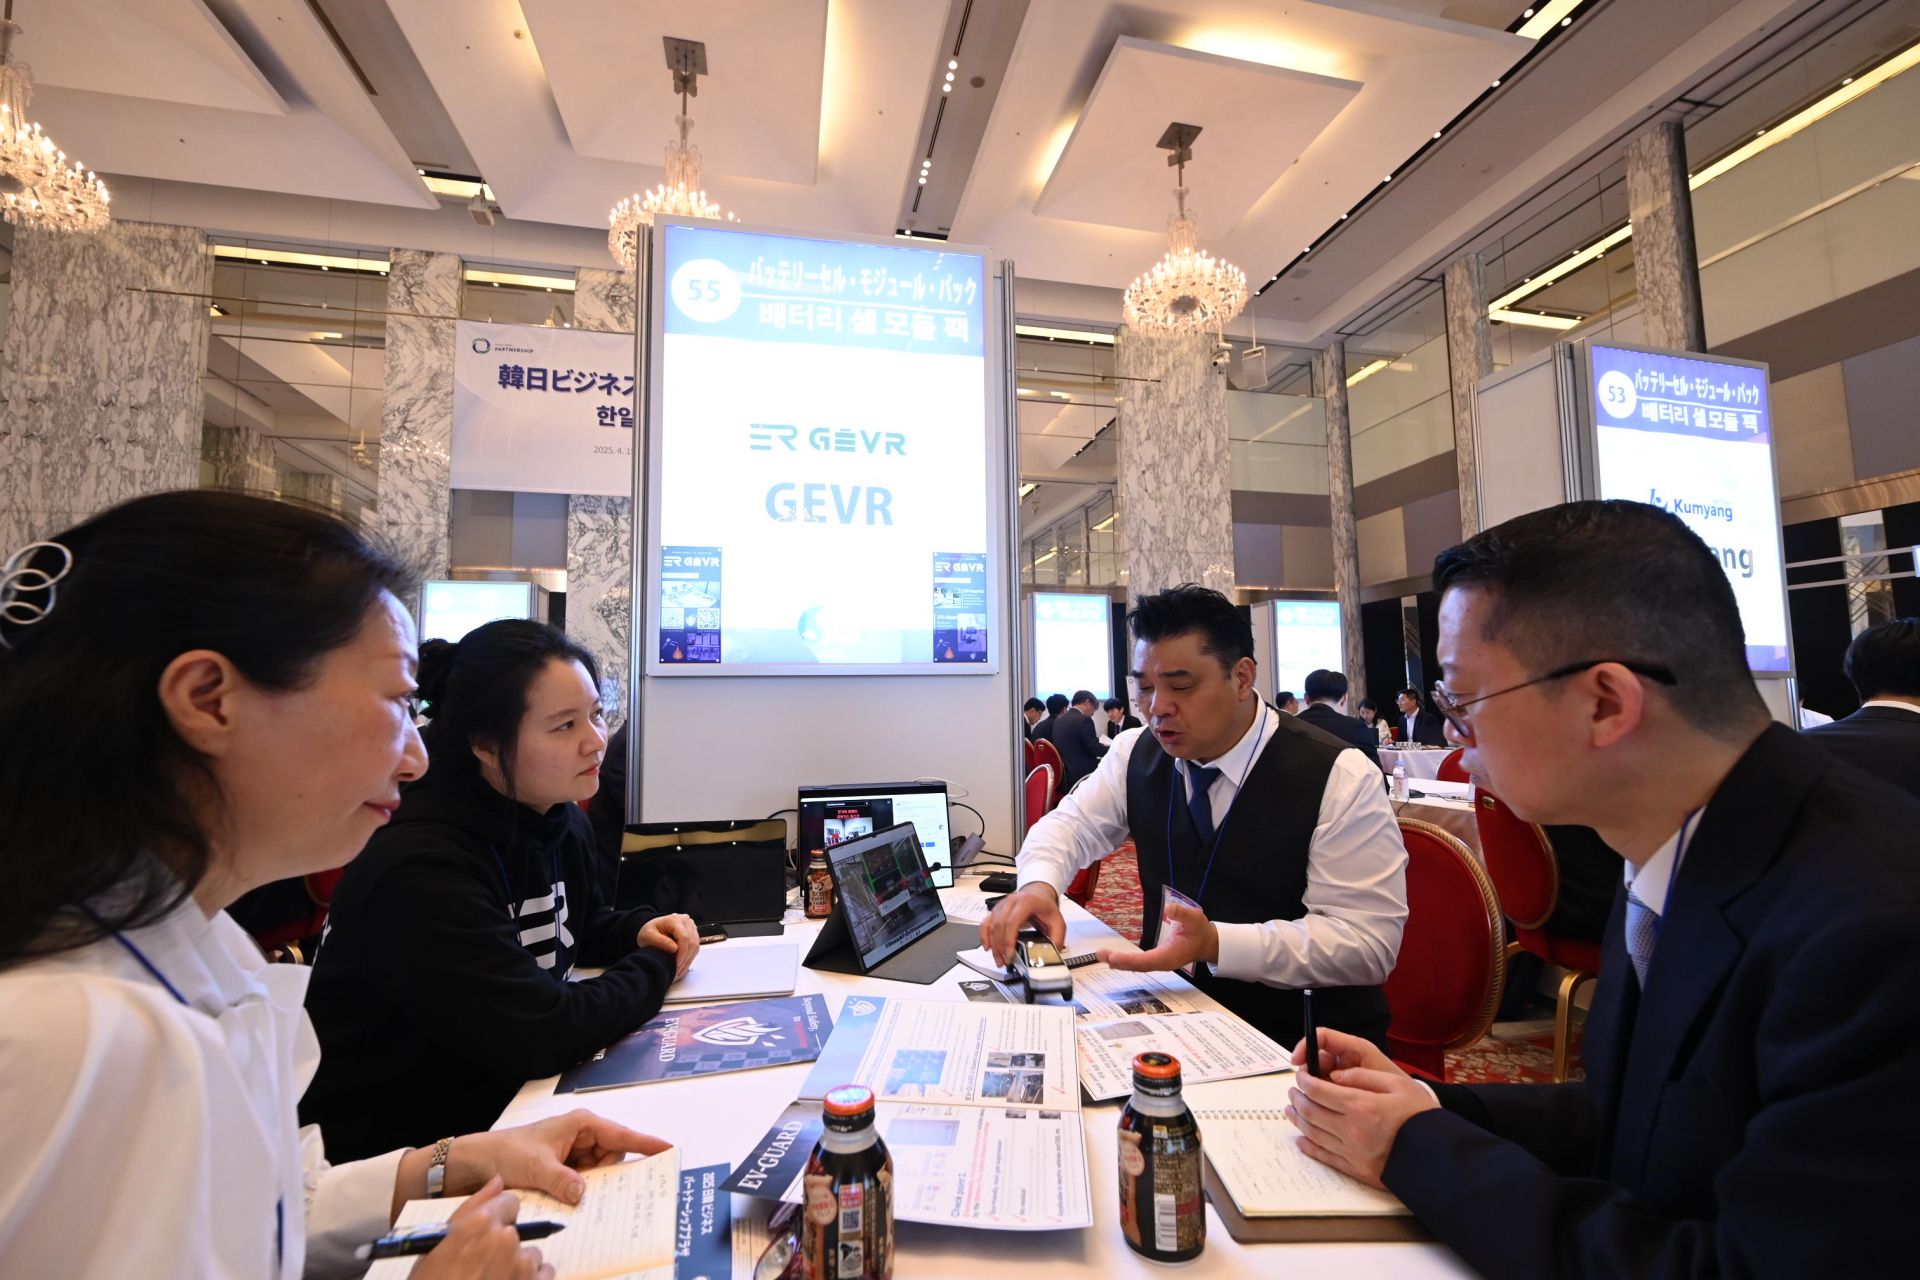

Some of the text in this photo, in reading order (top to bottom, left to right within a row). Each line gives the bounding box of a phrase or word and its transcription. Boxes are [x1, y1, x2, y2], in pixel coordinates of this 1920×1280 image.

[687, 279, 721, 302] 55
[759, 301, 970, 344] 배터리 셀 모듈 팩
[1608, 385, 1626, 403] 53
[1642, 402, 1689, 428] 배터리
[1742, 413, 1759, 434] 팩
[765, 482, 894, 526] GEVR
[1674, 499, 1733, 522] Kumyang
[659, 1017, 680, 1062] EV-GUARD
[736, 1120, 803, 1190] EV-GUARD
